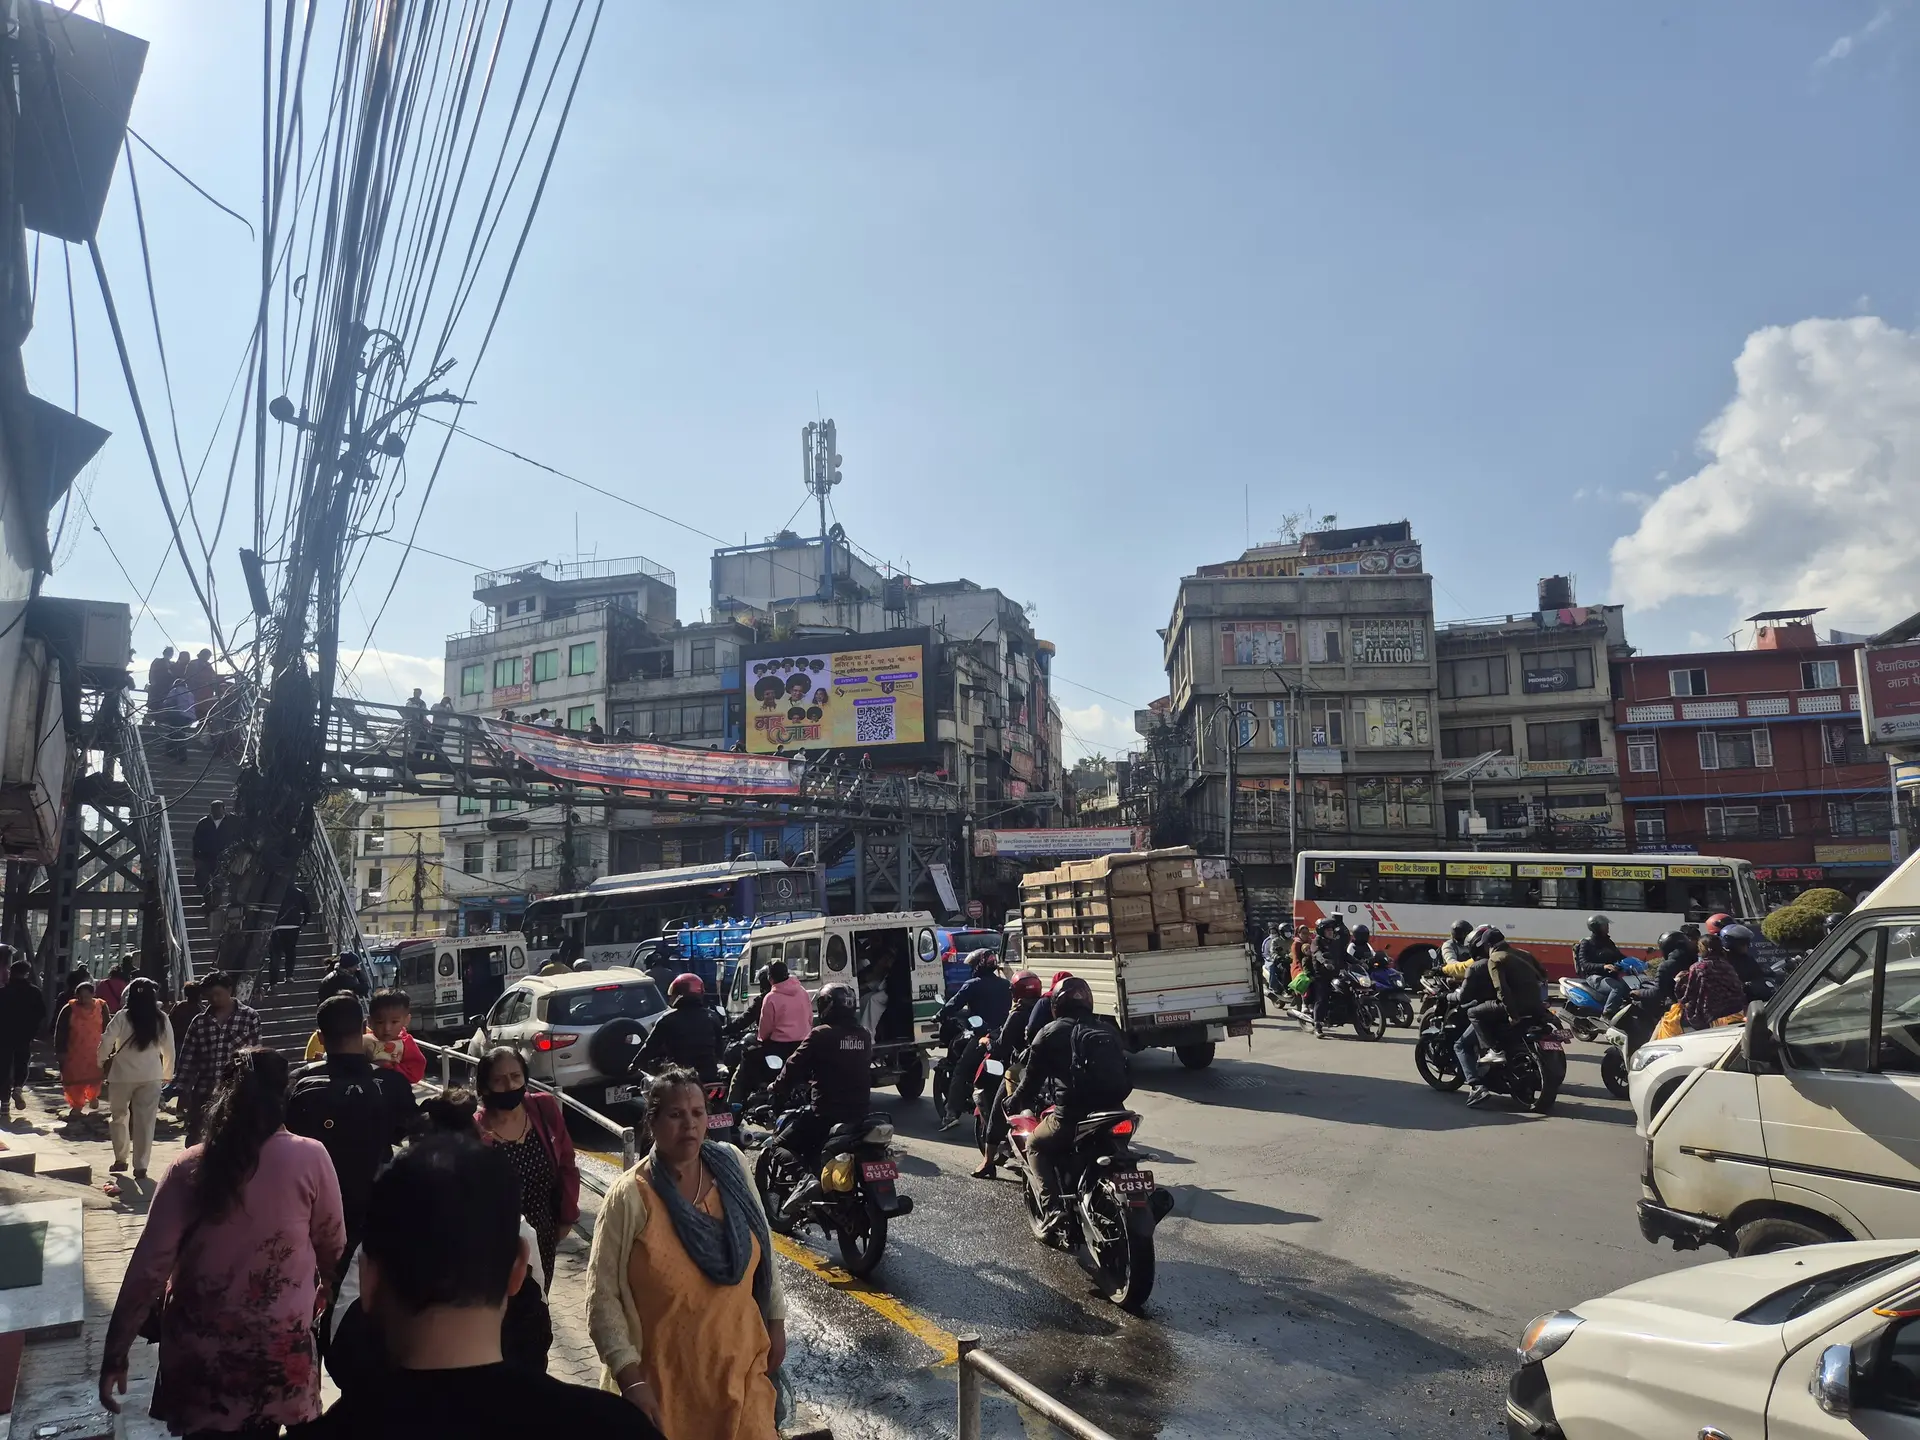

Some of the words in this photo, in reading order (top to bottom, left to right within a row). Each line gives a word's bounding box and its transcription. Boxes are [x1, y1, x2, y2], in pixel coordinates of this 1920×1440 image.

[1366, 648, 1411, 662] TATTOO
[522, 659, 530, 692] PMC
[1166, 870, 1182, 879] MUG
[840, 1040, 864, 1050] JINDAGI
